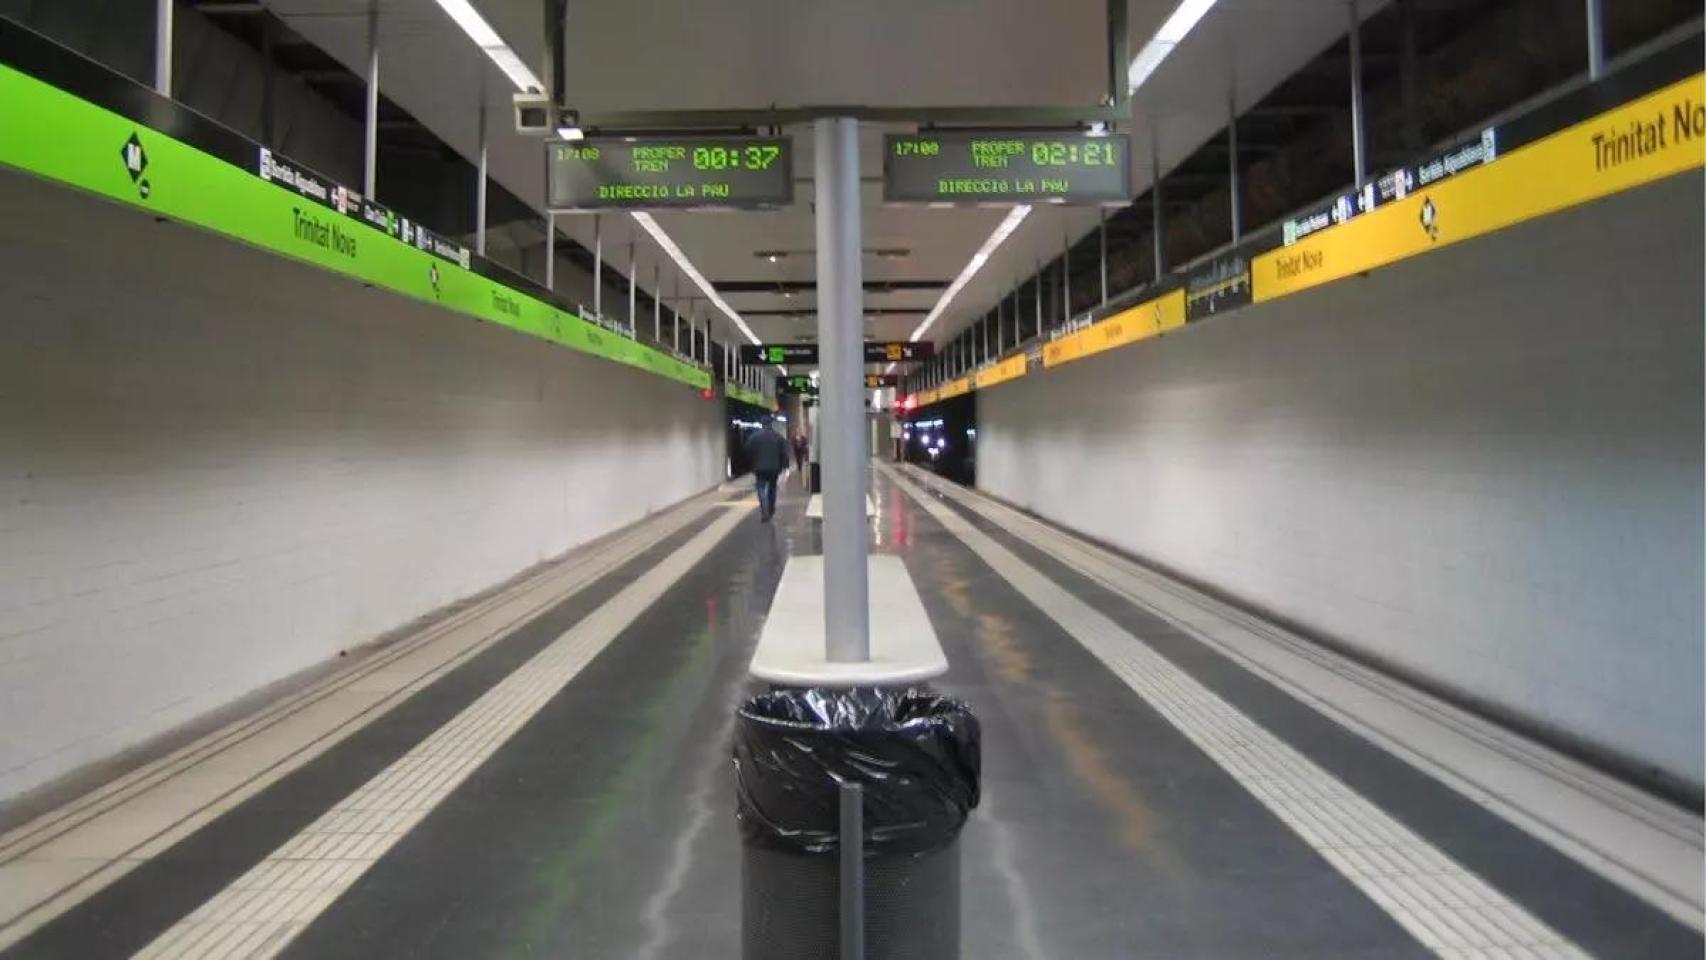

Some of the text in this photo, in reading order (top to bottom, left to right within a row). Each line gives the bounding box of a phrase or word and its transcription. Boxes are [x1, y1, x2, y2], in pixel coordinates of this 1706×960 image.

[972, 140, 1025, 155] PROPER
[1592, 111, 1667, 172] Trinitat
[557, 146, 600, 161] 17:08
[632, 146, 686, 160] PROPER
[693, 147, 779, 170] 00:37
[1032, 142, 1116, 166] 02:21
[634, 159, 669, 173] TREN
[974, 154, 1009, 169] TREN
[676, 184, 695, 198] LA
[702, 183, 729, 197] PAU
[1015, 179, 1035, 193] LA
[1041, 178, 1068, 193] PAU
[293, 206, 330, 249] Trinitat
[331, 224, 357, 259] Nova
[1276, 253, 1302, 280] Trinitat
[1303, 249, 1323, 273] Nova
